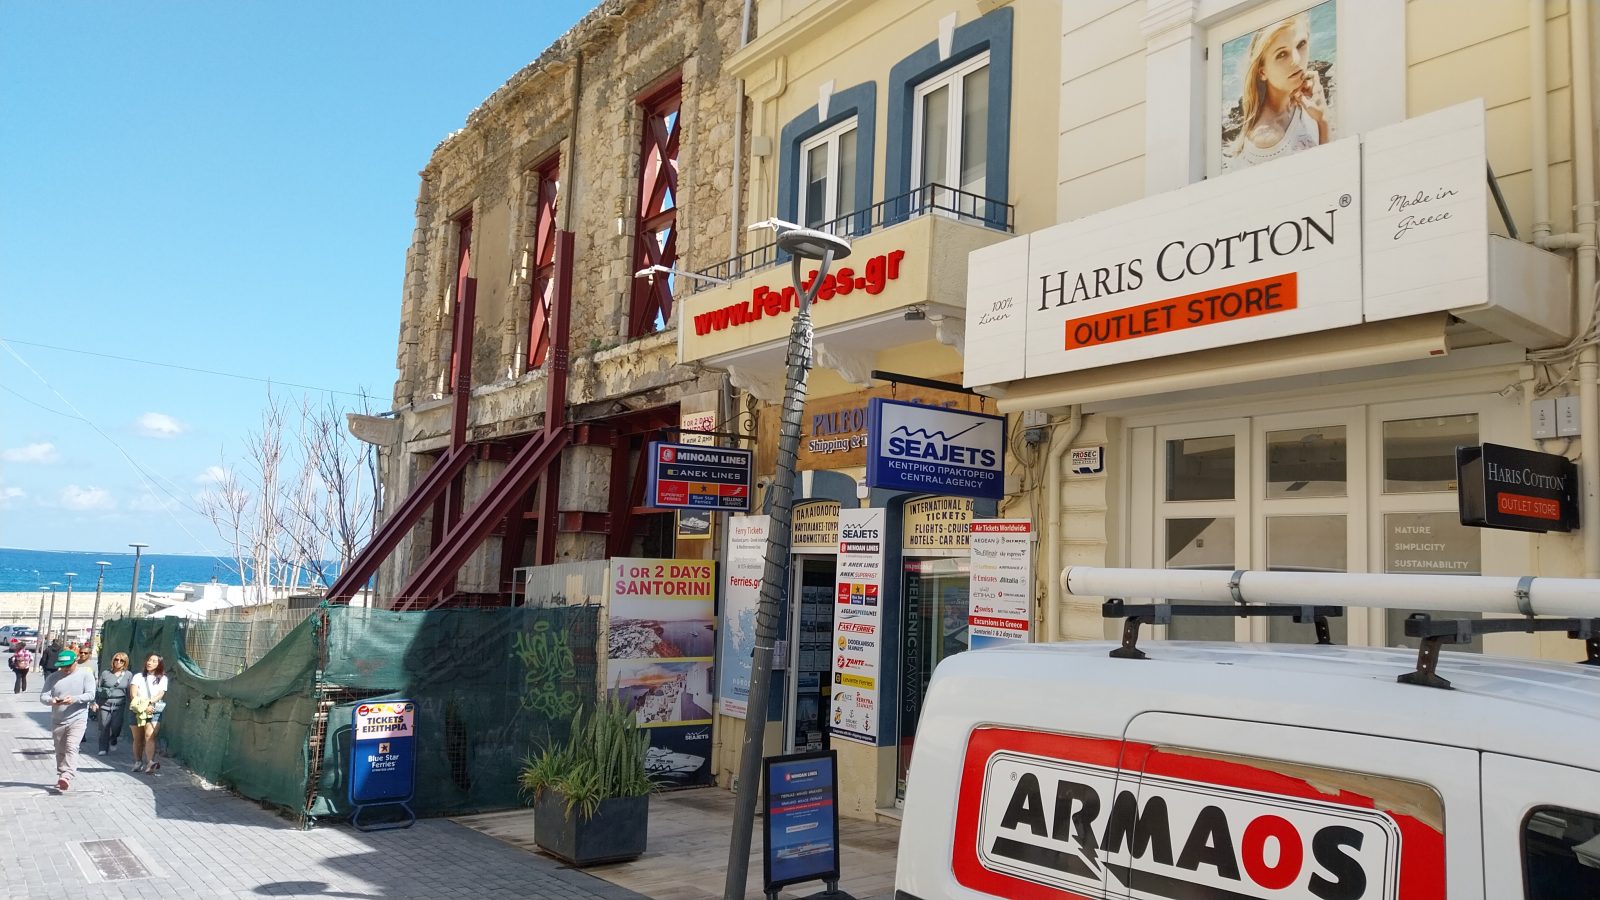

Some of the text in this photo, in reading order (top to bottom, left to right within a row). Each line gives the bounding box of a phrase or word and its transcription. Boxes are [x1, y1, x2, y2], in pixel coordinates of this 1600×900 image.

[1387, 187, 1460, 213] Made in
[1393, 210, 1453, 241] Greece
[1037, 208, 1338, 312] HARIS COTTON
[991, 296, 1014, 313] 100%
[978, 310, 1011, 327] Linen
[1073, 282, 1284, 346] OUTLET STORE
[812, 408, 869, 436] PALEO
[808, 437, 850, 455] Shipping
[851, 434, 861, 448] &
[677, 452, 747, 465] MINOAN LINES
[888, 437, 996, 467] SEAJETS
[1072, 450, 1097, 458] PROSEC
[680, 470, 741, 480] ANEK LINES
[888, 460, 995, 480] ΚΕΝΤΡΙΚΟ ΠΡΑΚΤΟΡΕΙΟ
[1487, 462, 1564, 491] HARIS COTTON
[900, 472, 983, 489] CENTRAL AGENCY
[910, 499, 962, 516] INTERNATIONAL
[1501, 498, 1557, 516] OUTLET STORE
[926, 512, 966, 521] TICKETS
[736, 527, 747, 536] Ferry
[842, 530, 878, 540] SEAJETS
[1394, 526, 1432, 534] NATURE
[956, 535, 972, 545] REN
[617, 565, 711, 578] 1 OR 2 DAYS
[1394, 560, 1470, 569] SUSTAINABILITY
[615, 581, 711, 596] SANTORINI
[730, 576, 760, 589] Ferries.gr
[838, 622, 852, 630] FAST
[1003, 630, 1011, 638] days
[846, 658, 864, 667] ZANTE
[367, 716, 404, 724] TICKETS
[362, 724, 408, 733] ΕΙΣΙΤΗΡΙΑ
[1000, 773, 1367, 900] ARMAOS
